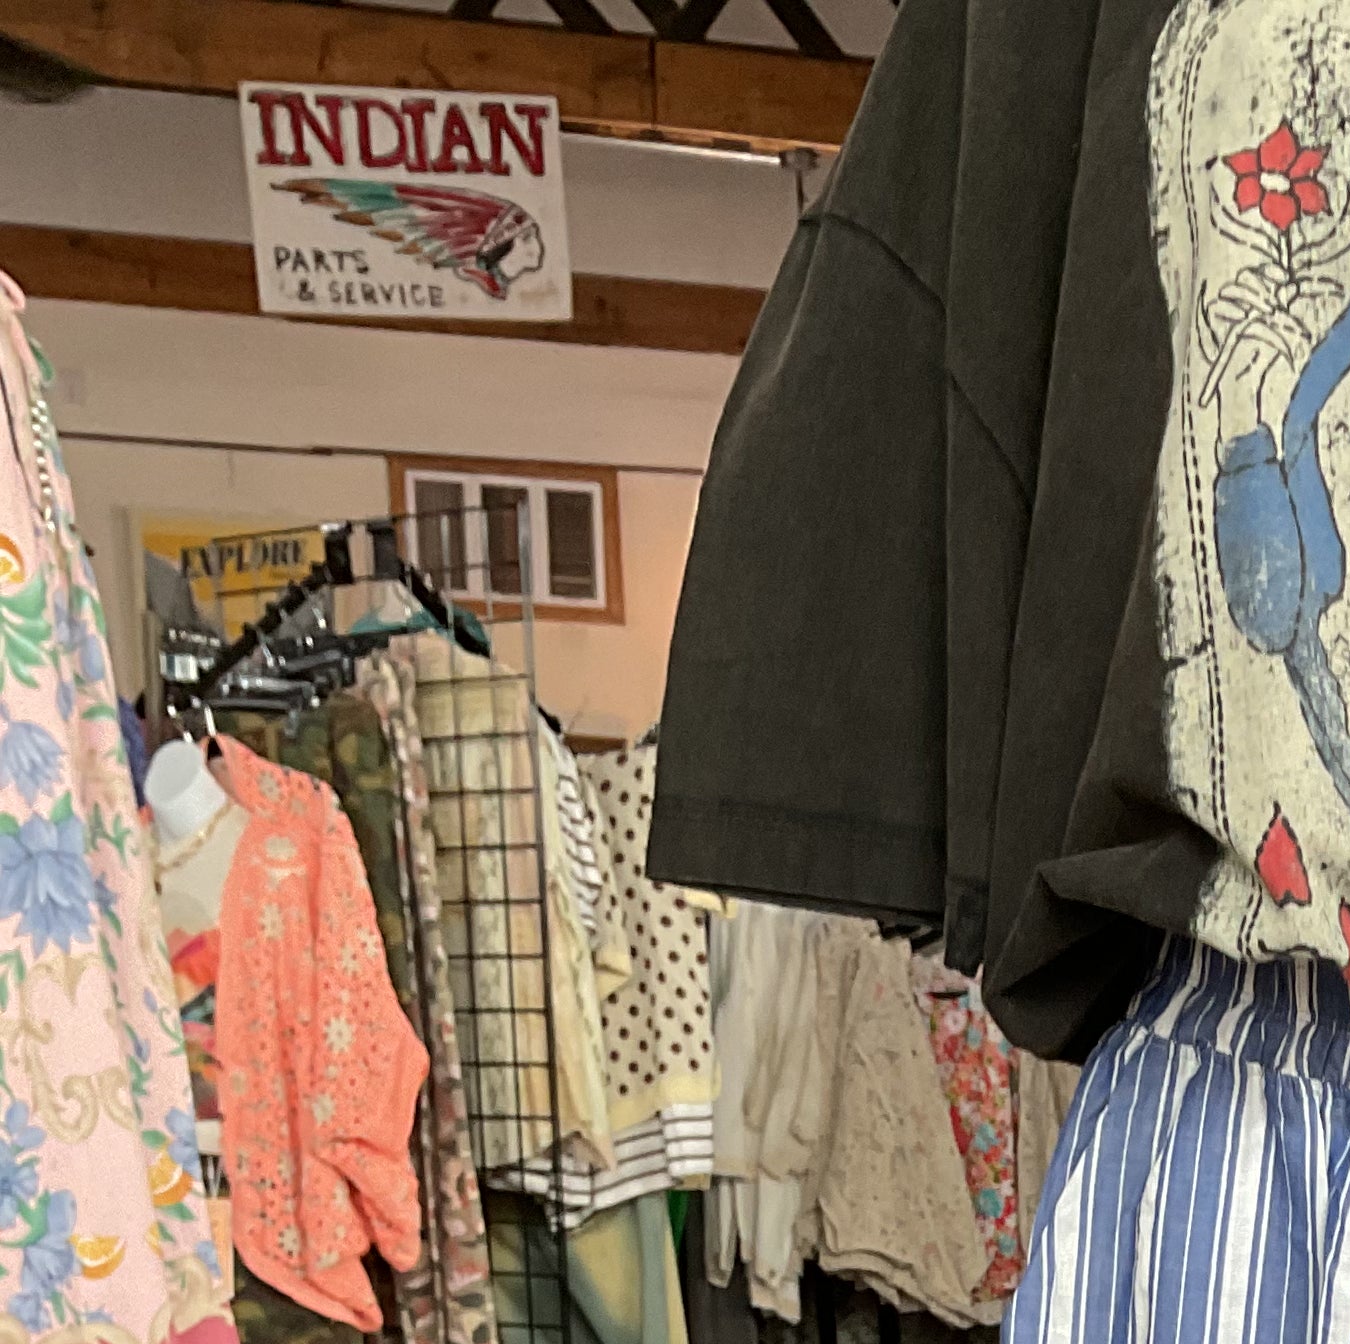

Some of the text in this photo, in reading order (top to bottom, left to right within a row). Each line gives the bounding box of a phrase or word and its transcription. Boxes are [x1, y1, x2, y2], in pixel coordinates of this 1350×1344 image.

[248, 91, 549, 176] INDIAN
[273, 245, 369, 274] PARTS
[297, 281, 445, 308] & SERVICE
